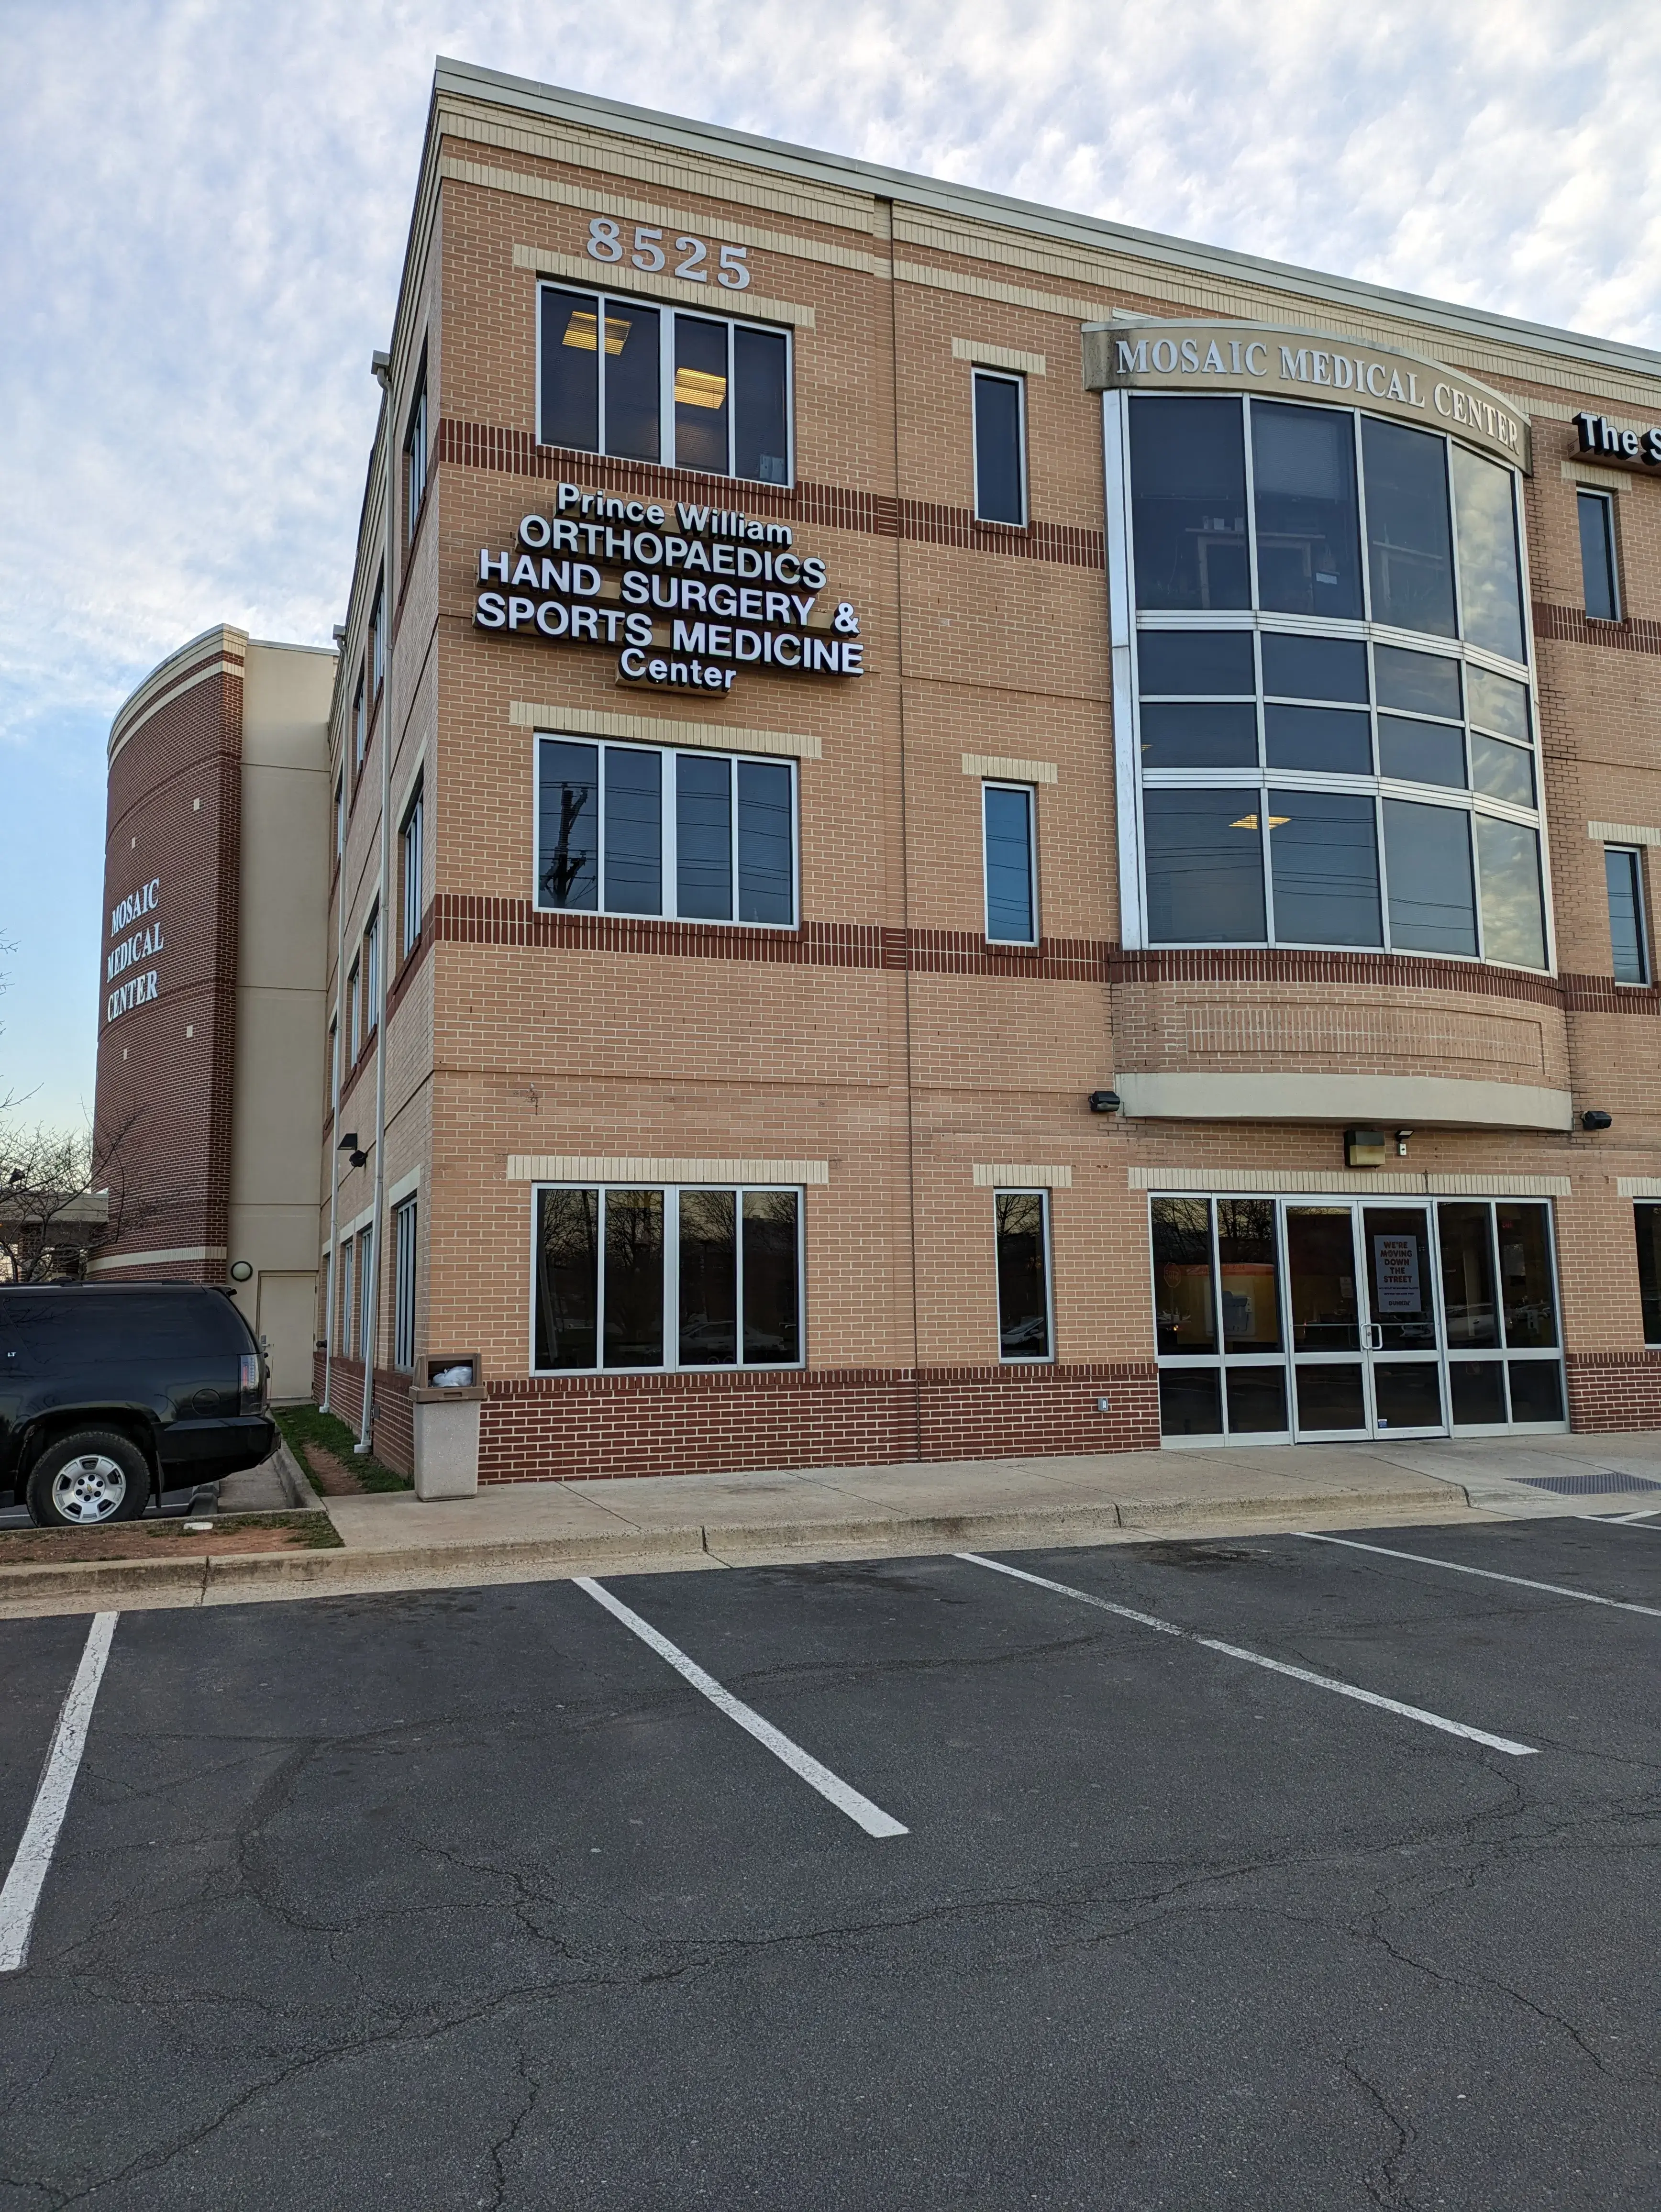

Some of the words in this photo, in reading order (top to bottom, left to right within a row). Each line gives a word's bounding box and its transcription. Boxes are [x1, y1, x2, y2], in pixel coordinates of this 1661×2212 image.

[587, 218, 751, 289] 8525
[1116, 340, 1267, 376] MOSAIC
[1279, 345, 1425, 408] MEDICAL
[1434, 383, 1519, 455] CENTER
[1580, 412, 1639, 455] The
[558, 483, 665, 526] Prince
[676, 502, 793, 546] William
[520, 514, 827, 589] ORTHOPAEDICS
[480, 548, 601, 597] HAND
[622, 572, 815, 626] SURGERY
[834, 602, 860, 635] &
[476, 593, 653, 646] SPORTS
[673, 619, 864, 675] MEDICINE
[620, 649, 737, 690] Center
[111, 877, 159, 938] MOSAIC
[107, 922, 164, 983] MEDICAL
[107, 970, 157, 1022] CENTER
